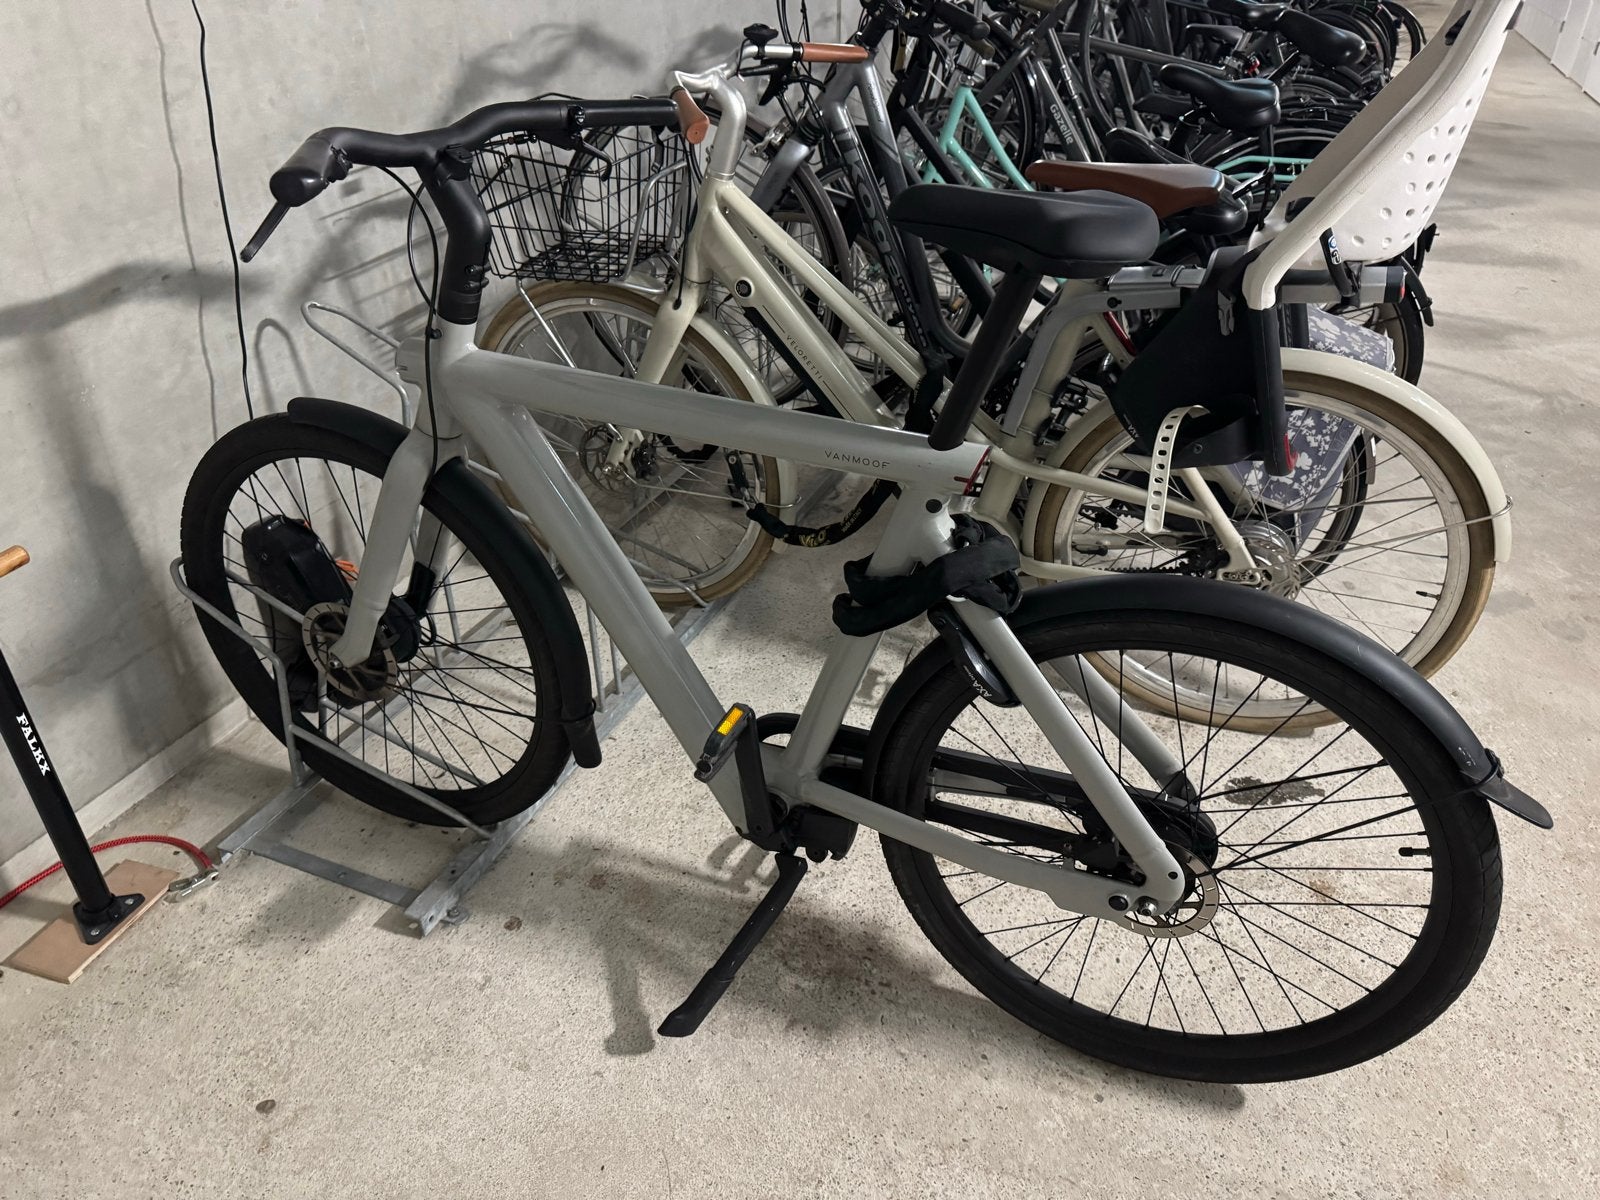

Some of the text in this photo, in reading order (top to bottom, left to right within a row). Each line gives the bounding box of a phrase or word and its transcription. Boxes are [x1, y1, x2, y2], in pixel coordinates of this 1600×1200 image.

[1050, 103, 1074, 145] Gazelle
[786, 334, 823, 380] VELORETTI
[824, 450, 890, 469] VANMOOF
[972, 680, 993, 697] AXA
[15, 711, 51, 777] FALKX
